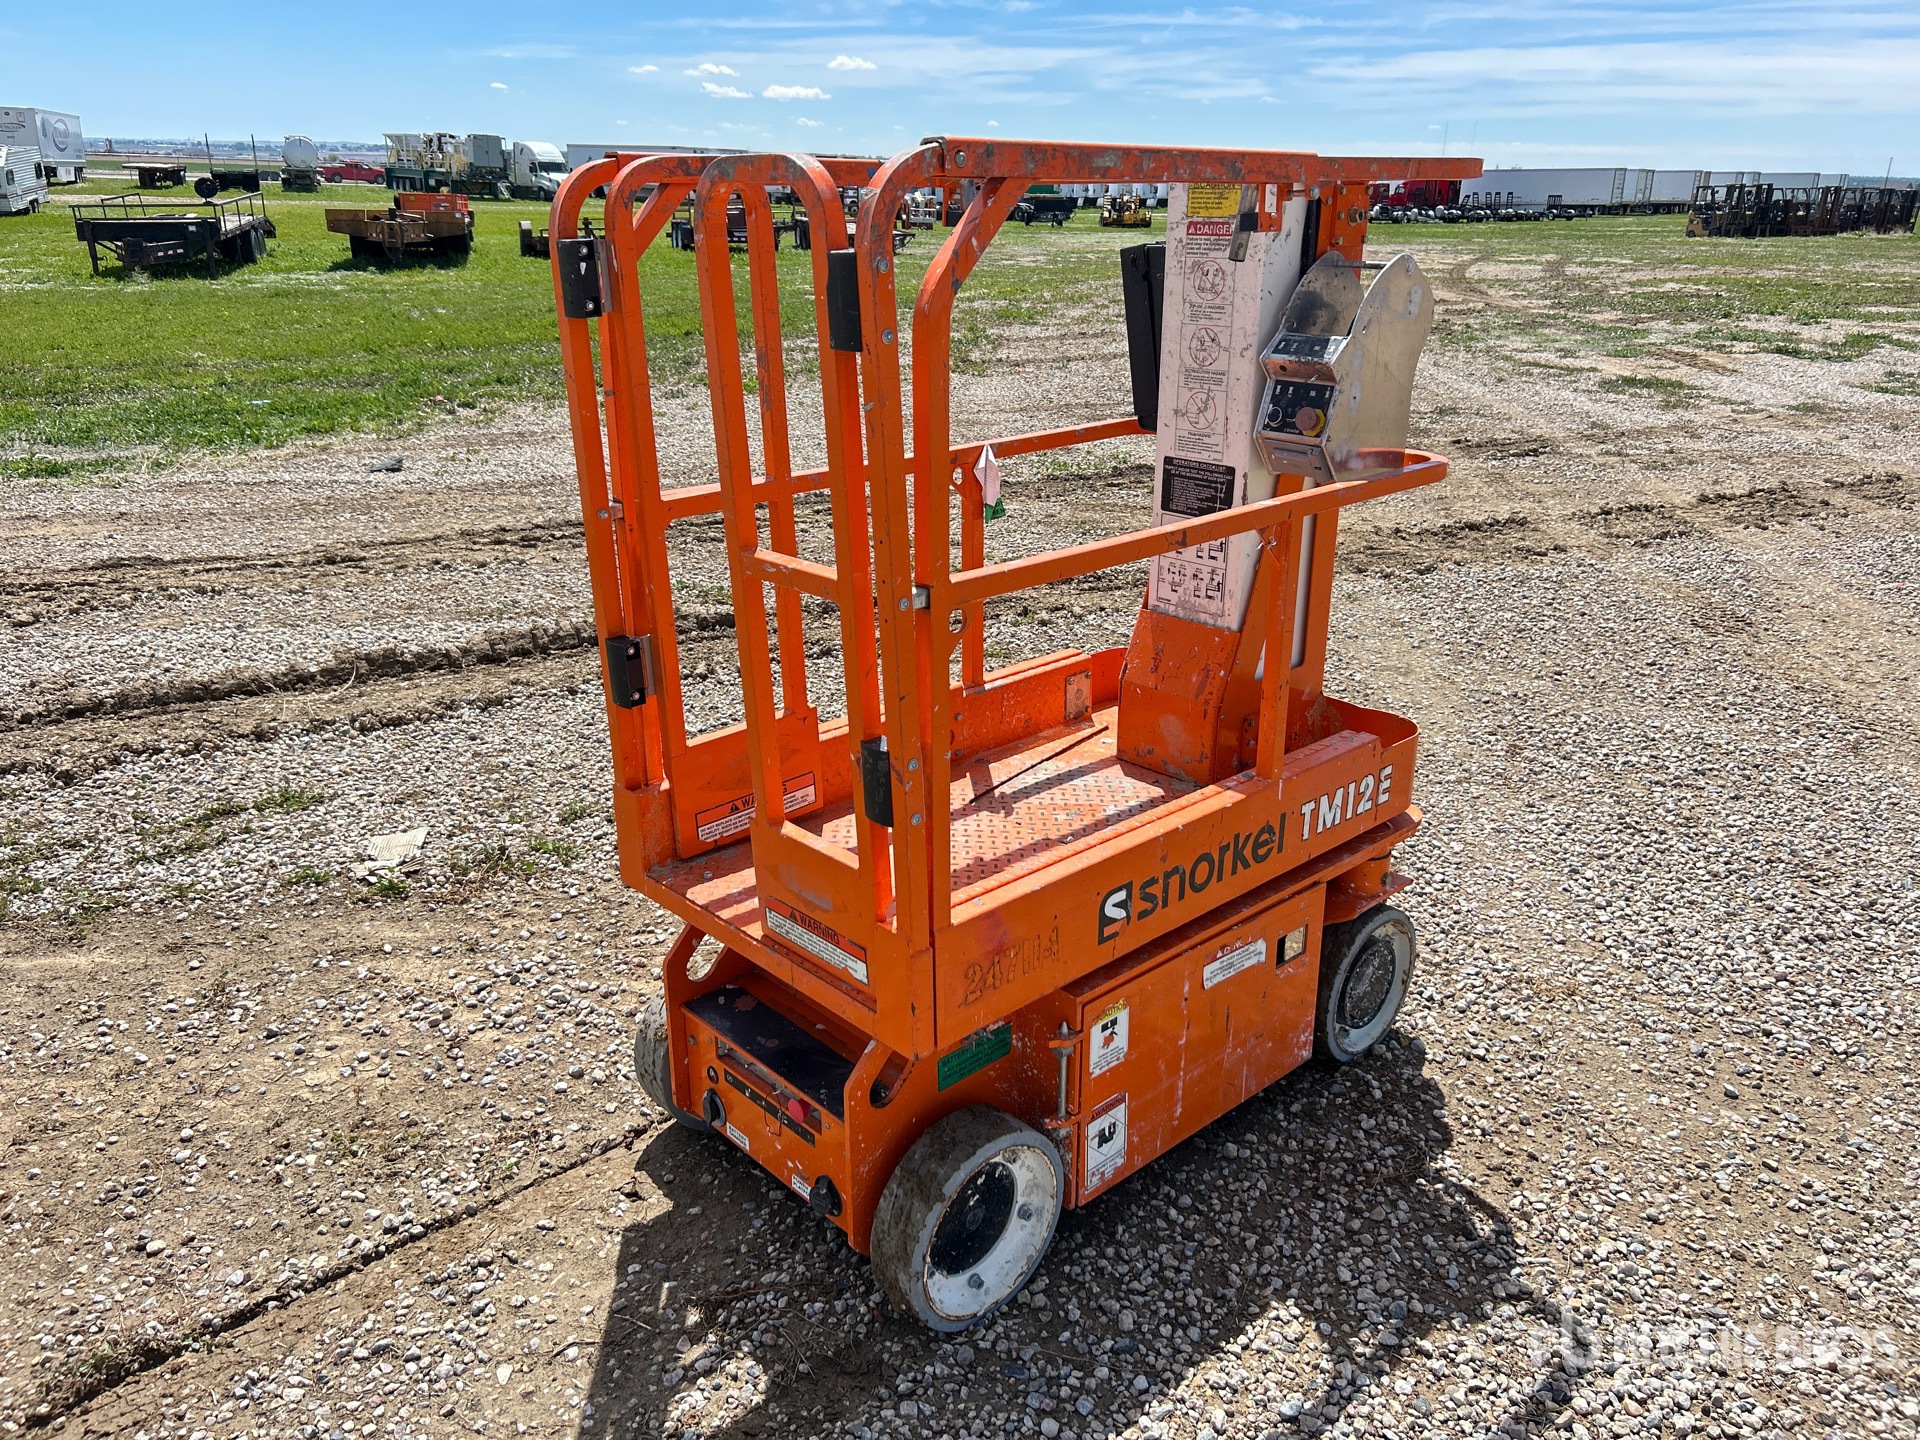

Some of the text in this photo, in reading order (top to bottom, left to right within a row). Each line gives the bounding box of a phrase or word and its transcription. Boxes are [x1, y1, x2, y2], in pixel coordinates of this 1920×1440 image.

[1172, 458, 1199, 467] OPERATORS
[1300, 764, 1394, 842] TM12E
[1137, 812, 1286, 921] snorkel
[800, 913, 840, 945] WARNING
